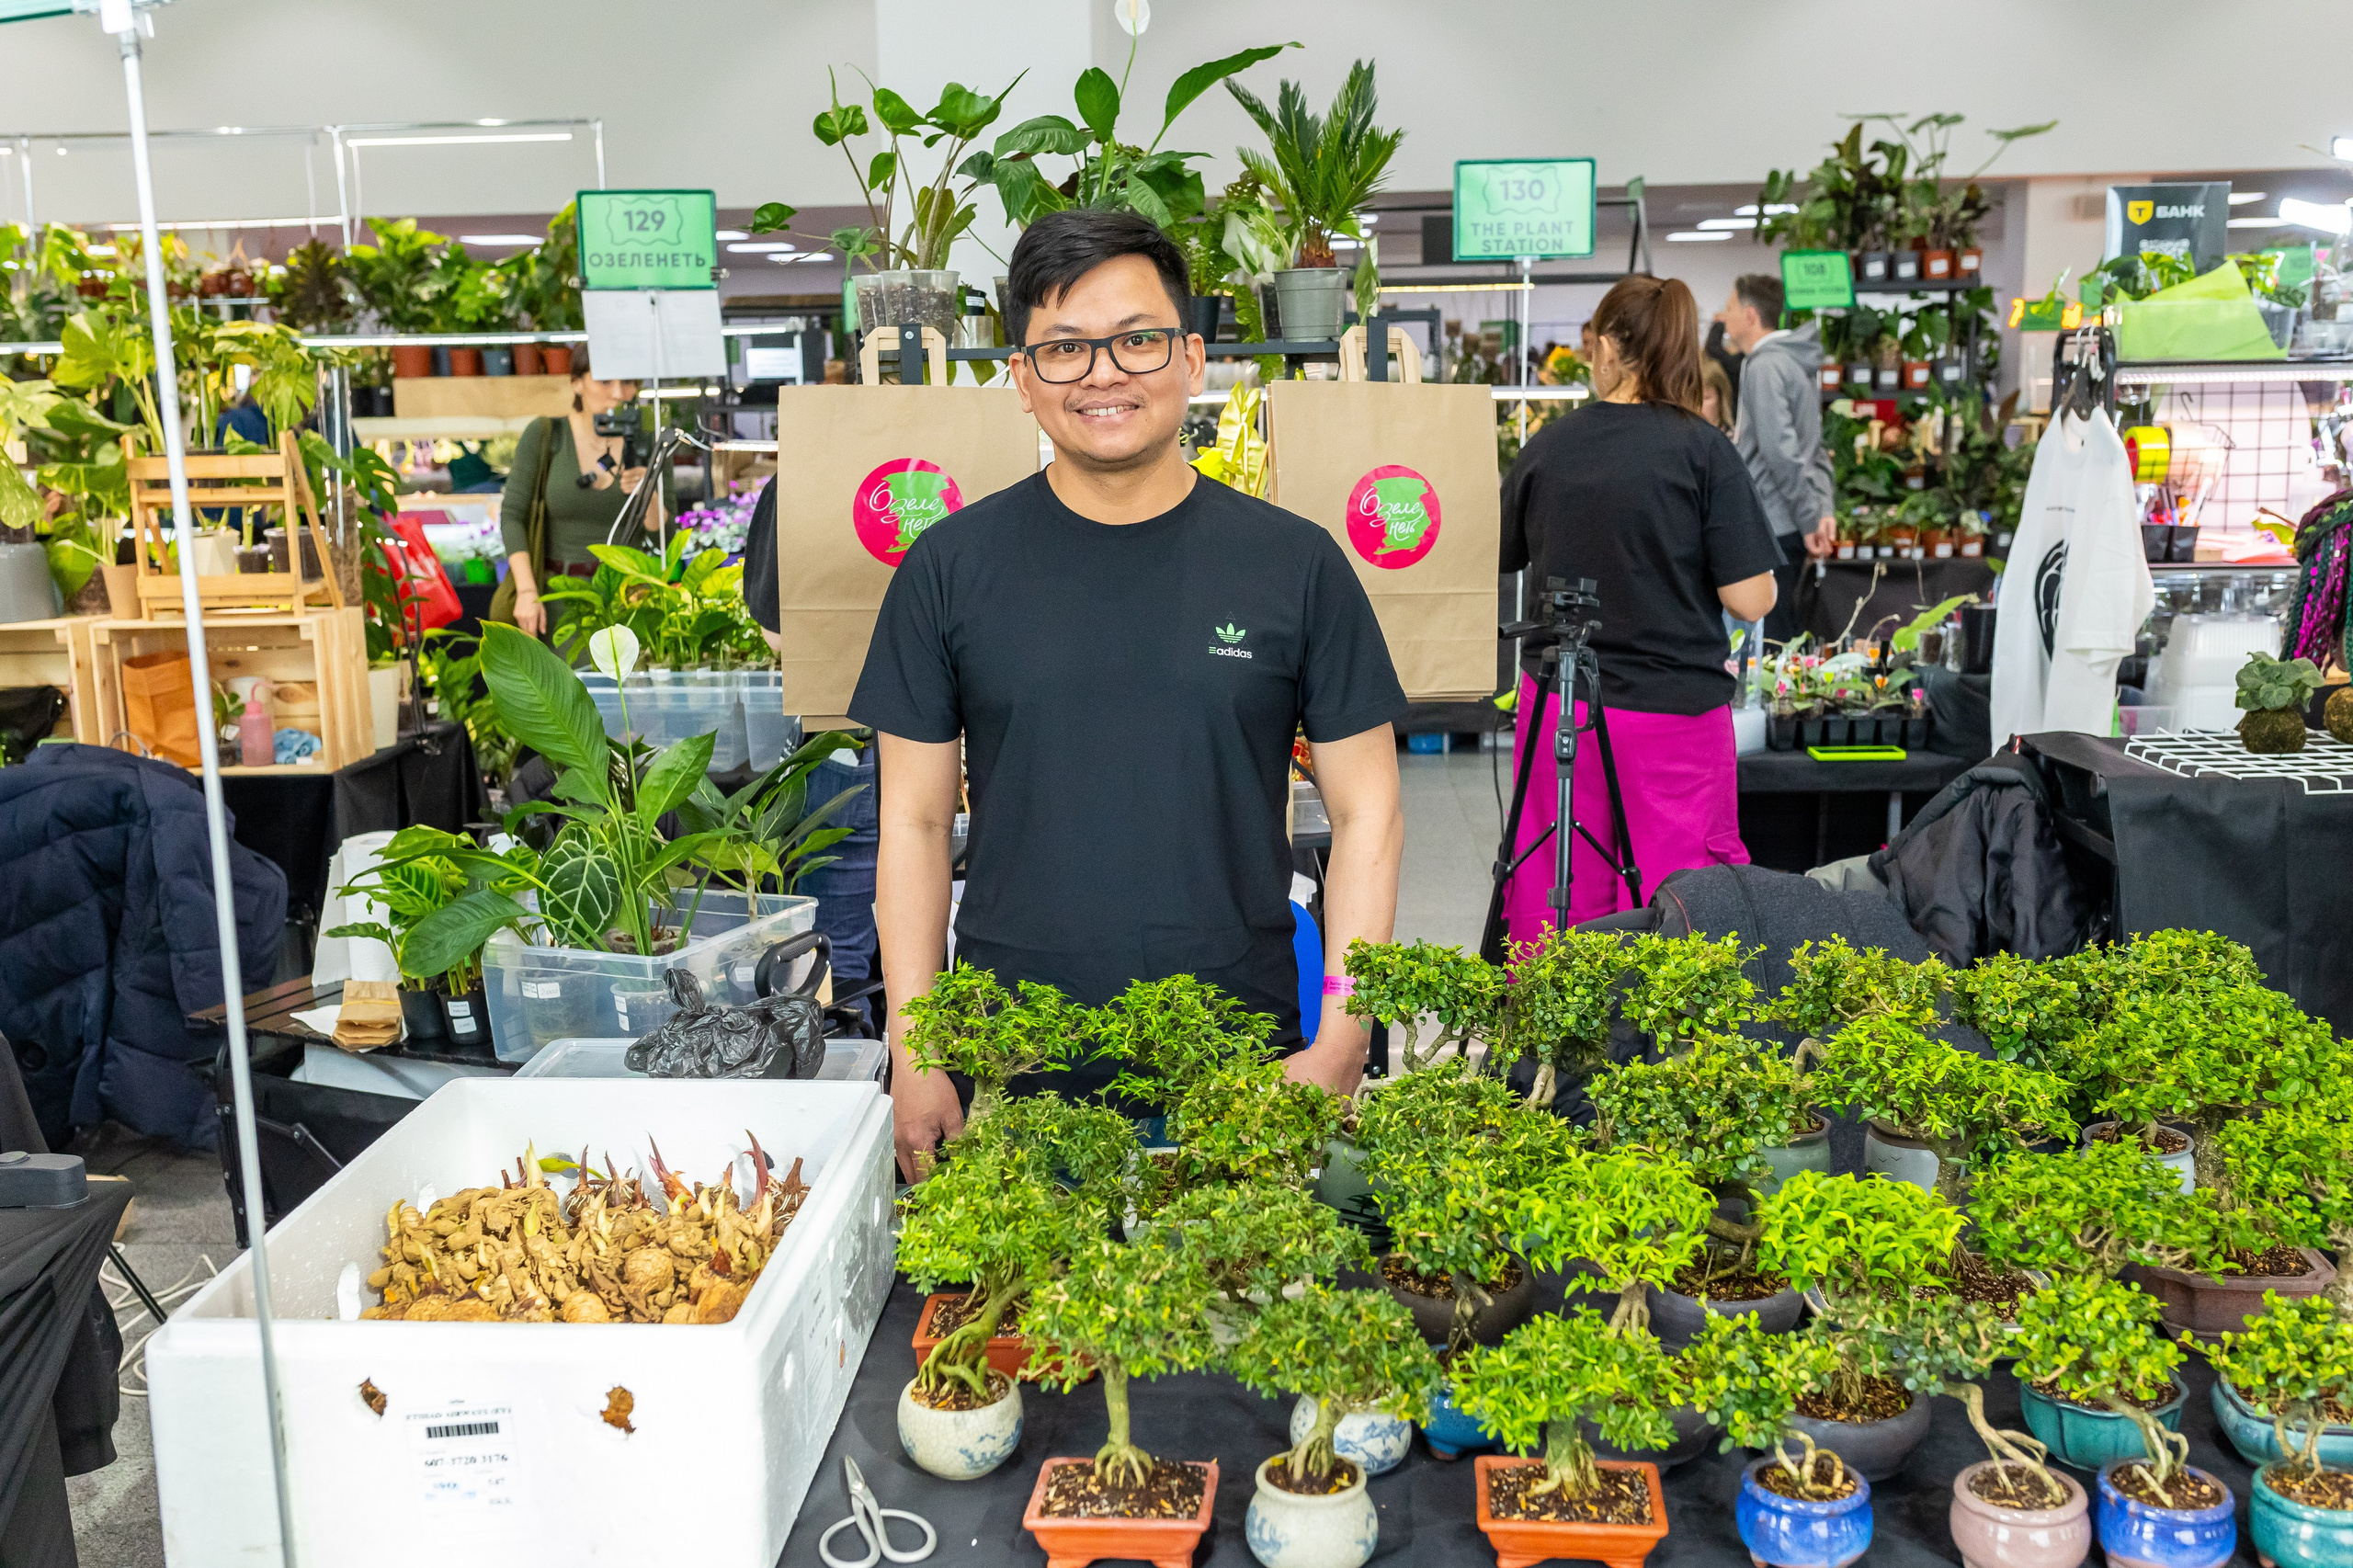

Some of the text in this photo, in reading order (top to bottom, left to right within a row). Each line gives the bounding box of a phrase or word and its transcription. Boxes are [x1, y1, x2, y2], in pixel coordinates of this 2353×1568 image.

[1500, 178, 1545, 200] 130
[2155, 204, 2205, 219] БАНК
[623, 210, 665, 232] 129
[1471, 221, 1574, 237] THE PLANT
[1482, 238, 1563, 253] STATION
[588, 252, 706, 268] ОЗЕЛЕНЕТЬ
[1216, 647, 1253, 659] adidas
